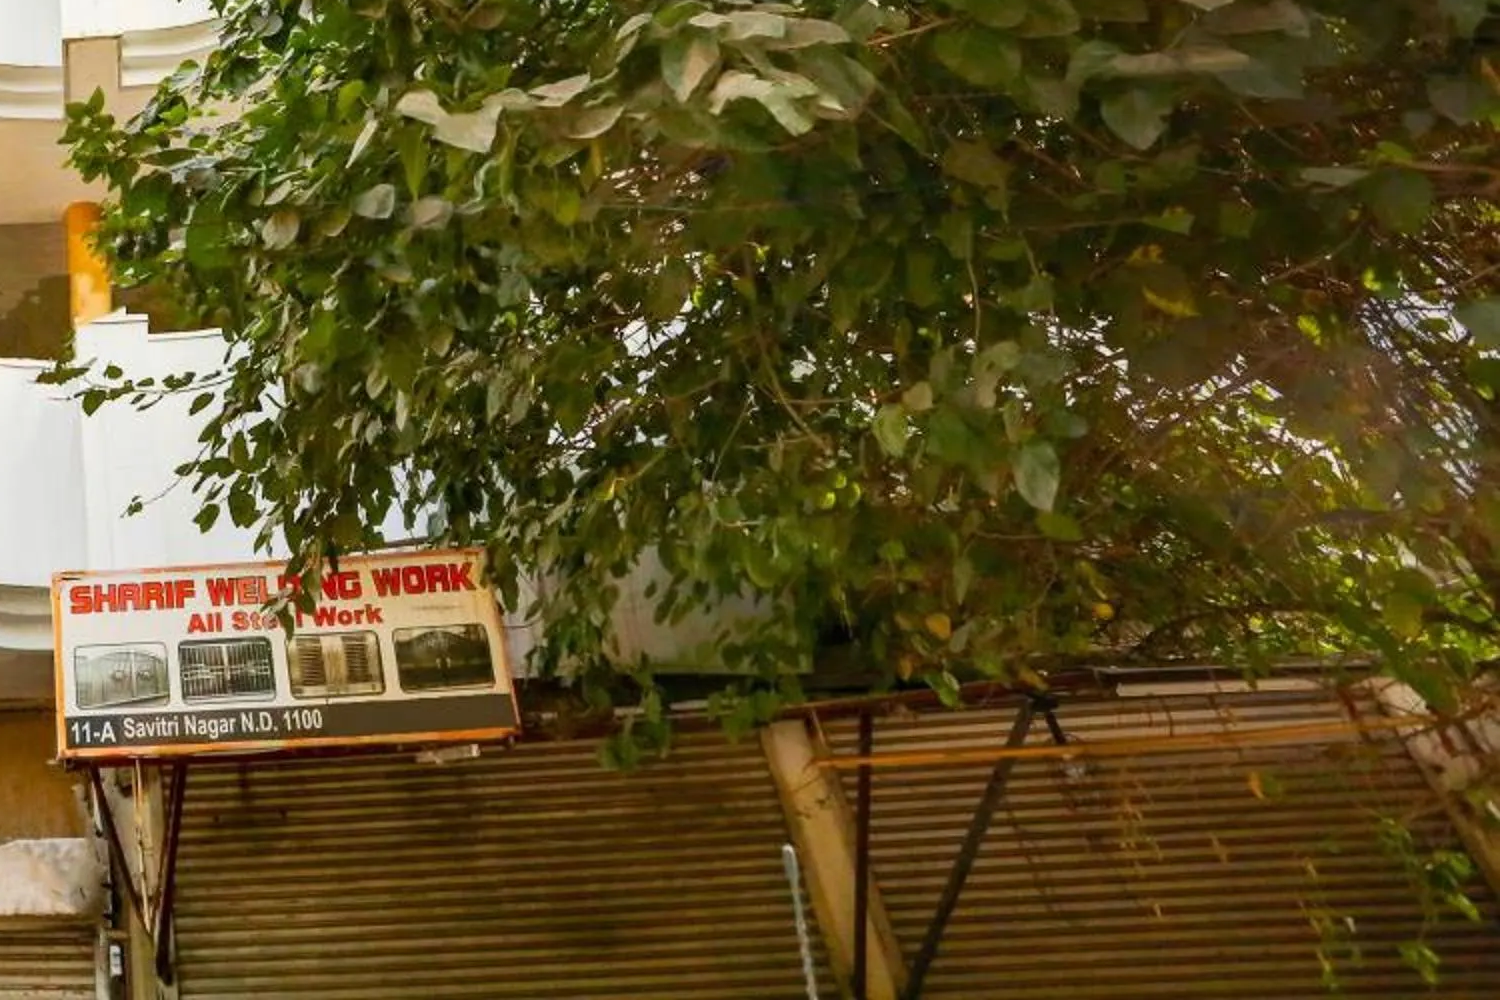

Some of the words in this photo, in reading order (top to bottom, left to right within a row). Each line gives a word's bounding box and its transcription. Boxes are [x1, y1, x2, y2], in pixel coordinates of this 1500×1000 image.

[69, 579, 195, 615] SHARIF
[206, 571, 363, 607] WELDNG
[371, 561, 477, 598] WORK
[187, 612, 223, 633] All
[231, 607, 303, 632] Stel
[313, 603, 383, 628] Work
[71, 721, 117, 744] 11-A
[123, 714, 180, 739] Savitri
[184, 714, 237, 740] Nagar
[240, 711, 278, 733] N.D.
[283, 708, 323, 731] 1100
